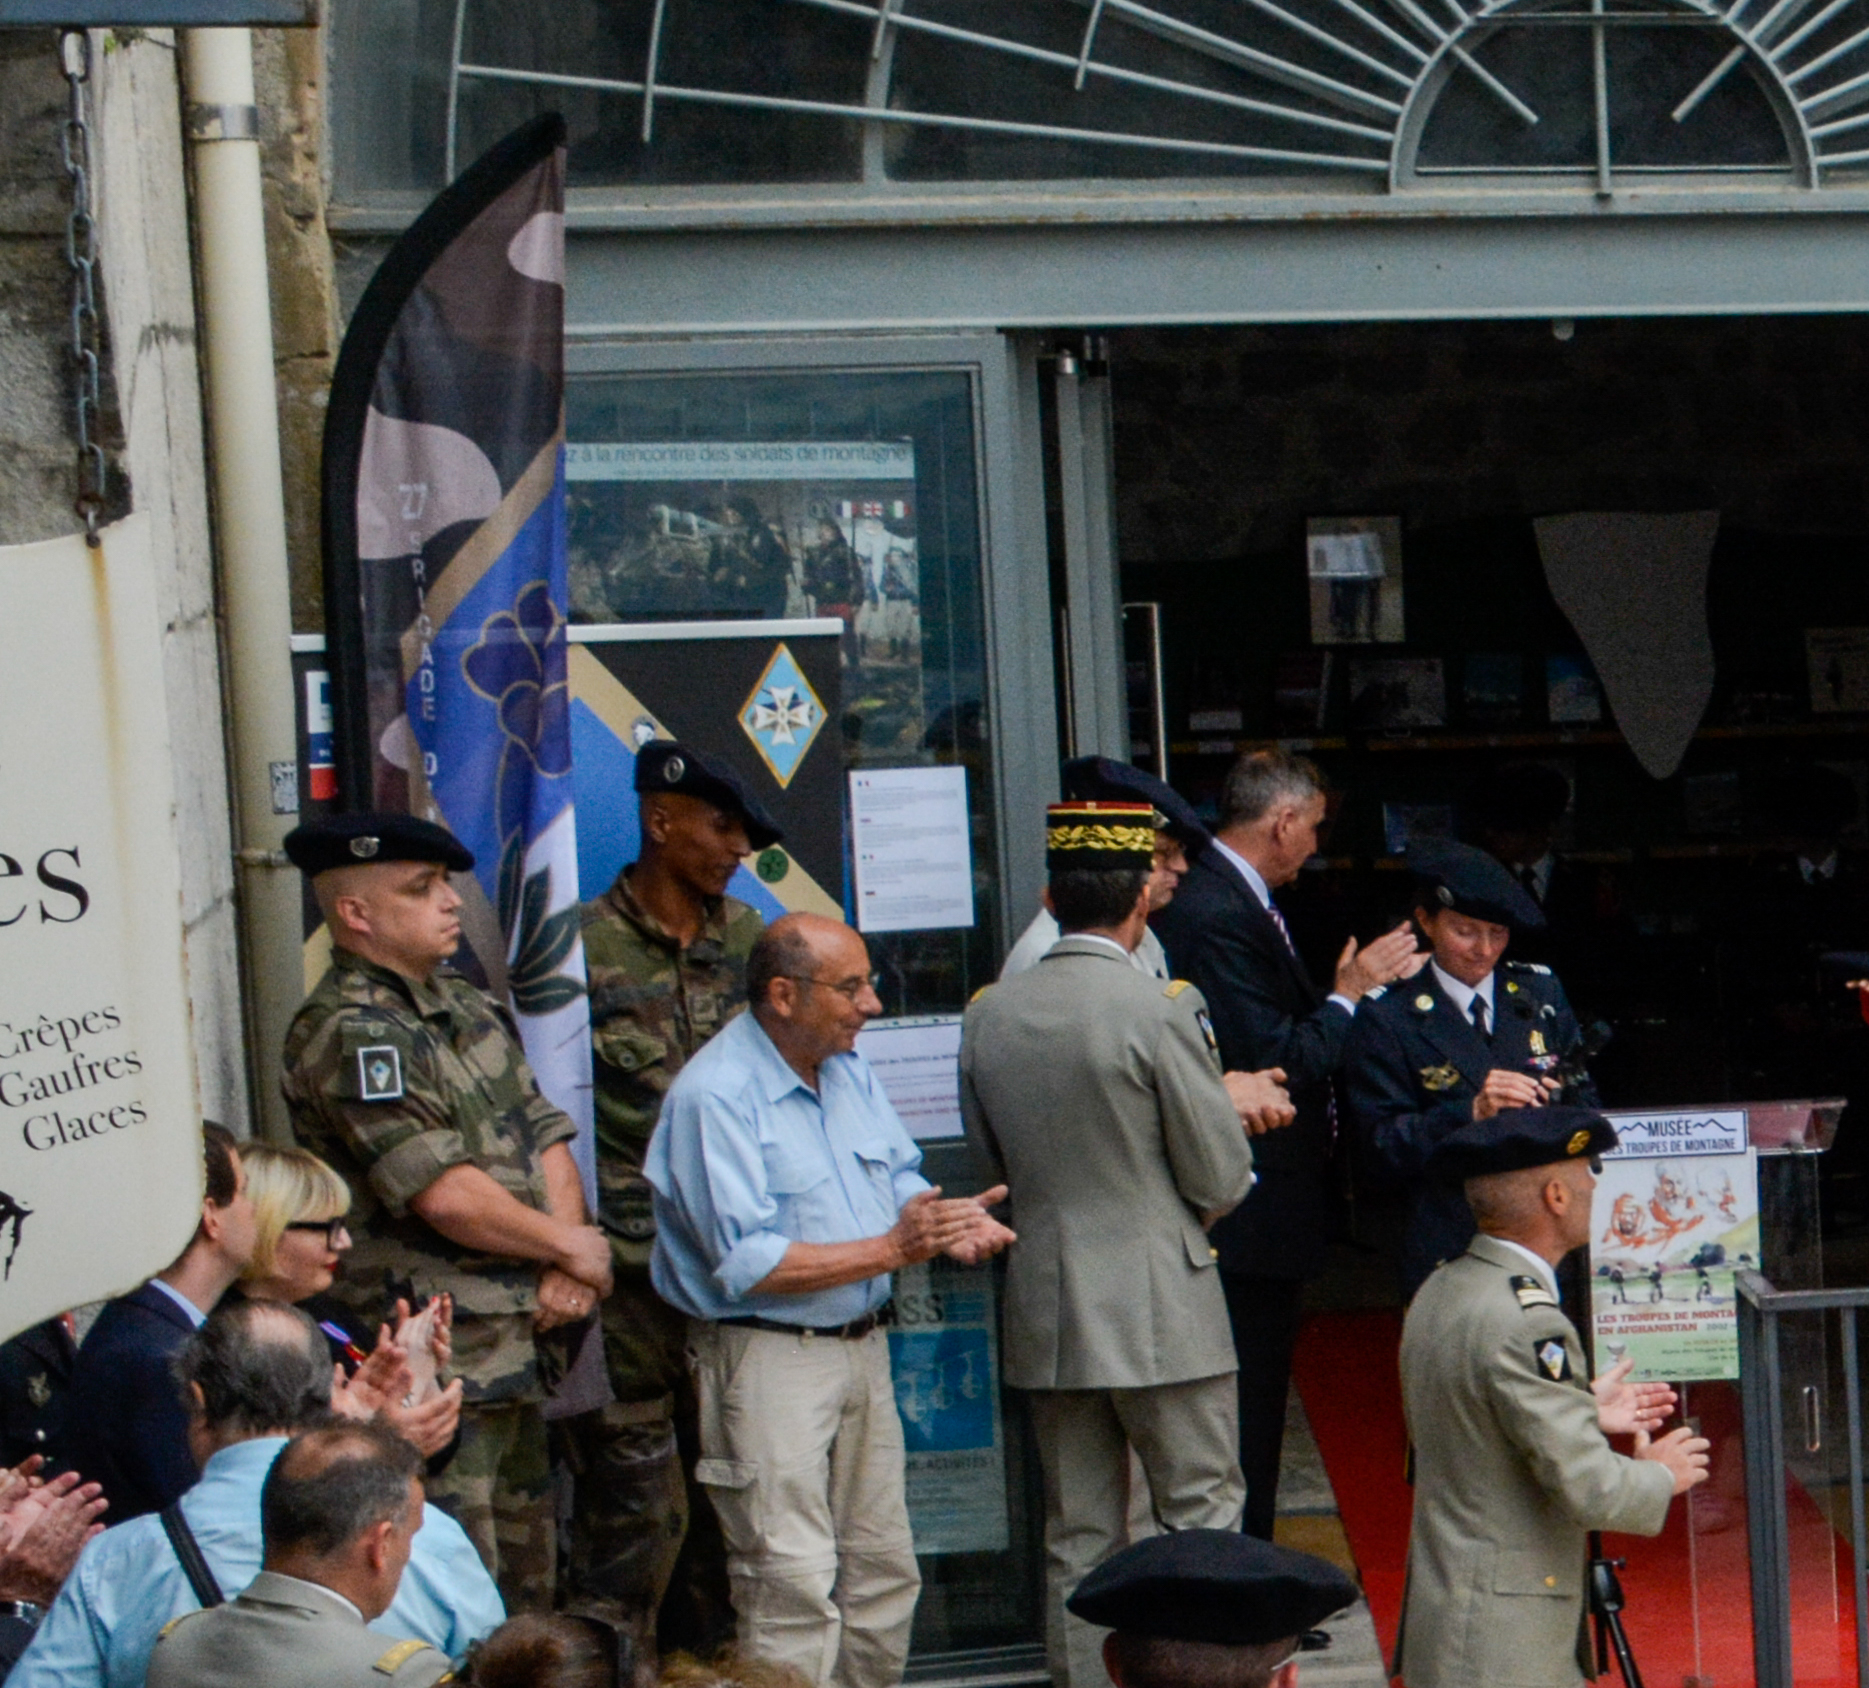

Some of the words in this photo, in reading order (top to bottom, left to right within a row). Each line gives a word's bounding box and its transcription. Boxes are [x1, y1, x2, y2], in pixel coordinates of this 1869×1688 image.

[0, 1049, 143, 1108] Gaufres
[23, 1098, 148, 1153] Glaces
[1647, 1117, 1692, 1137] MUSÉE
[1626, 1141, 1668, 1154] TROUPES
[1670, 1140, 1682, 1152] DE
[1685, 1138, 1736, 1150] MONTAGNE
[1597, 1314, 1617, 1324] LES
[1621, 1312, 1671, 1323] TROUPES
[1674, 1311, 1688, 1321] DE
[1598, 1326, 1614, 1335] EN
[1617, 1323, 1697, 1334] AFGHANISTAN
